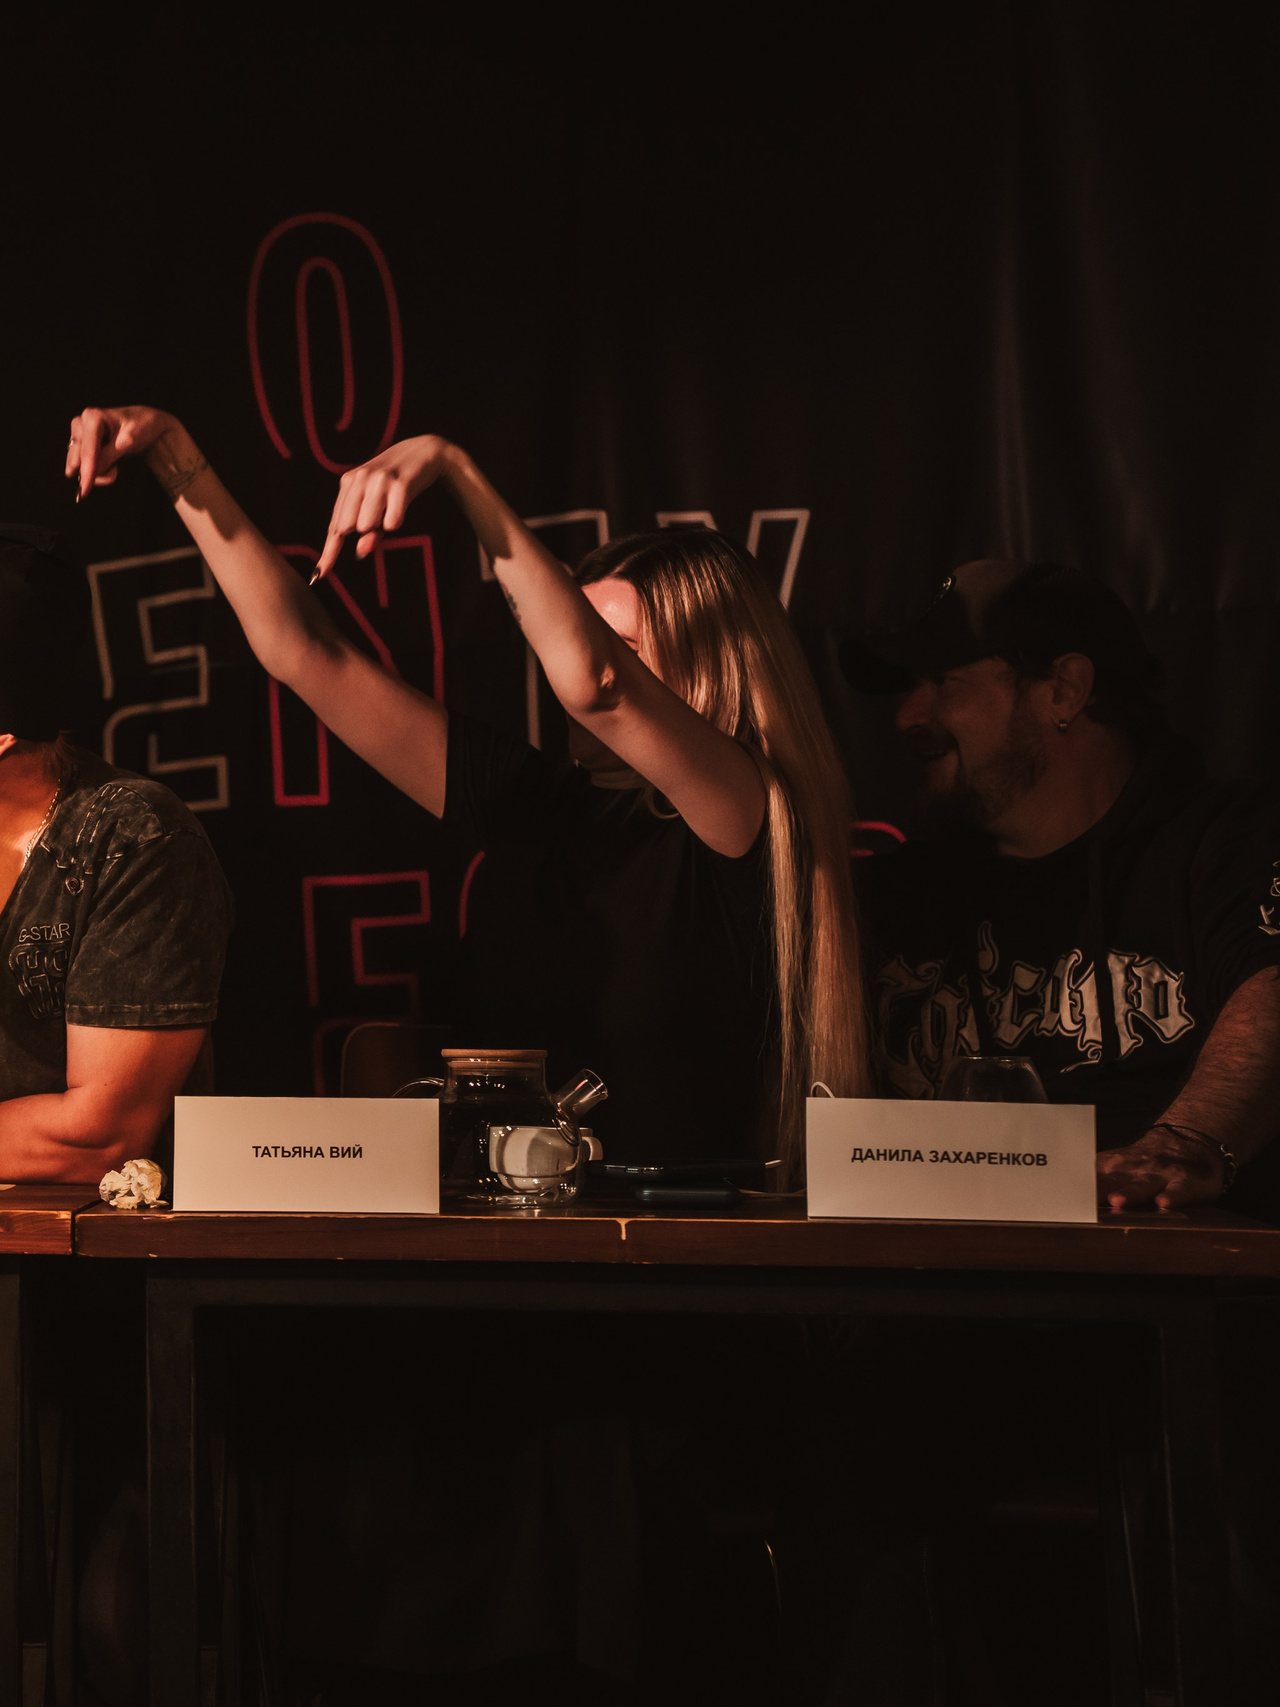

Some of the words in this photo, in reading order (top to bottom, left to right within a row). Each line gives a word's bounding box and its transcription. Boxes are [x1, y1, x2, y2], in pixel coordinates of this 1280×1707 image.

[251, 1145, 325, 1159] ТАТЬЯНА
[329, 1143, 363, 1159] ВИЙ
[850, 1147, 925, 1164] ДАНИЛА
[928, 1150, 1048, 1167] ЗАХАРЕНКОВ
